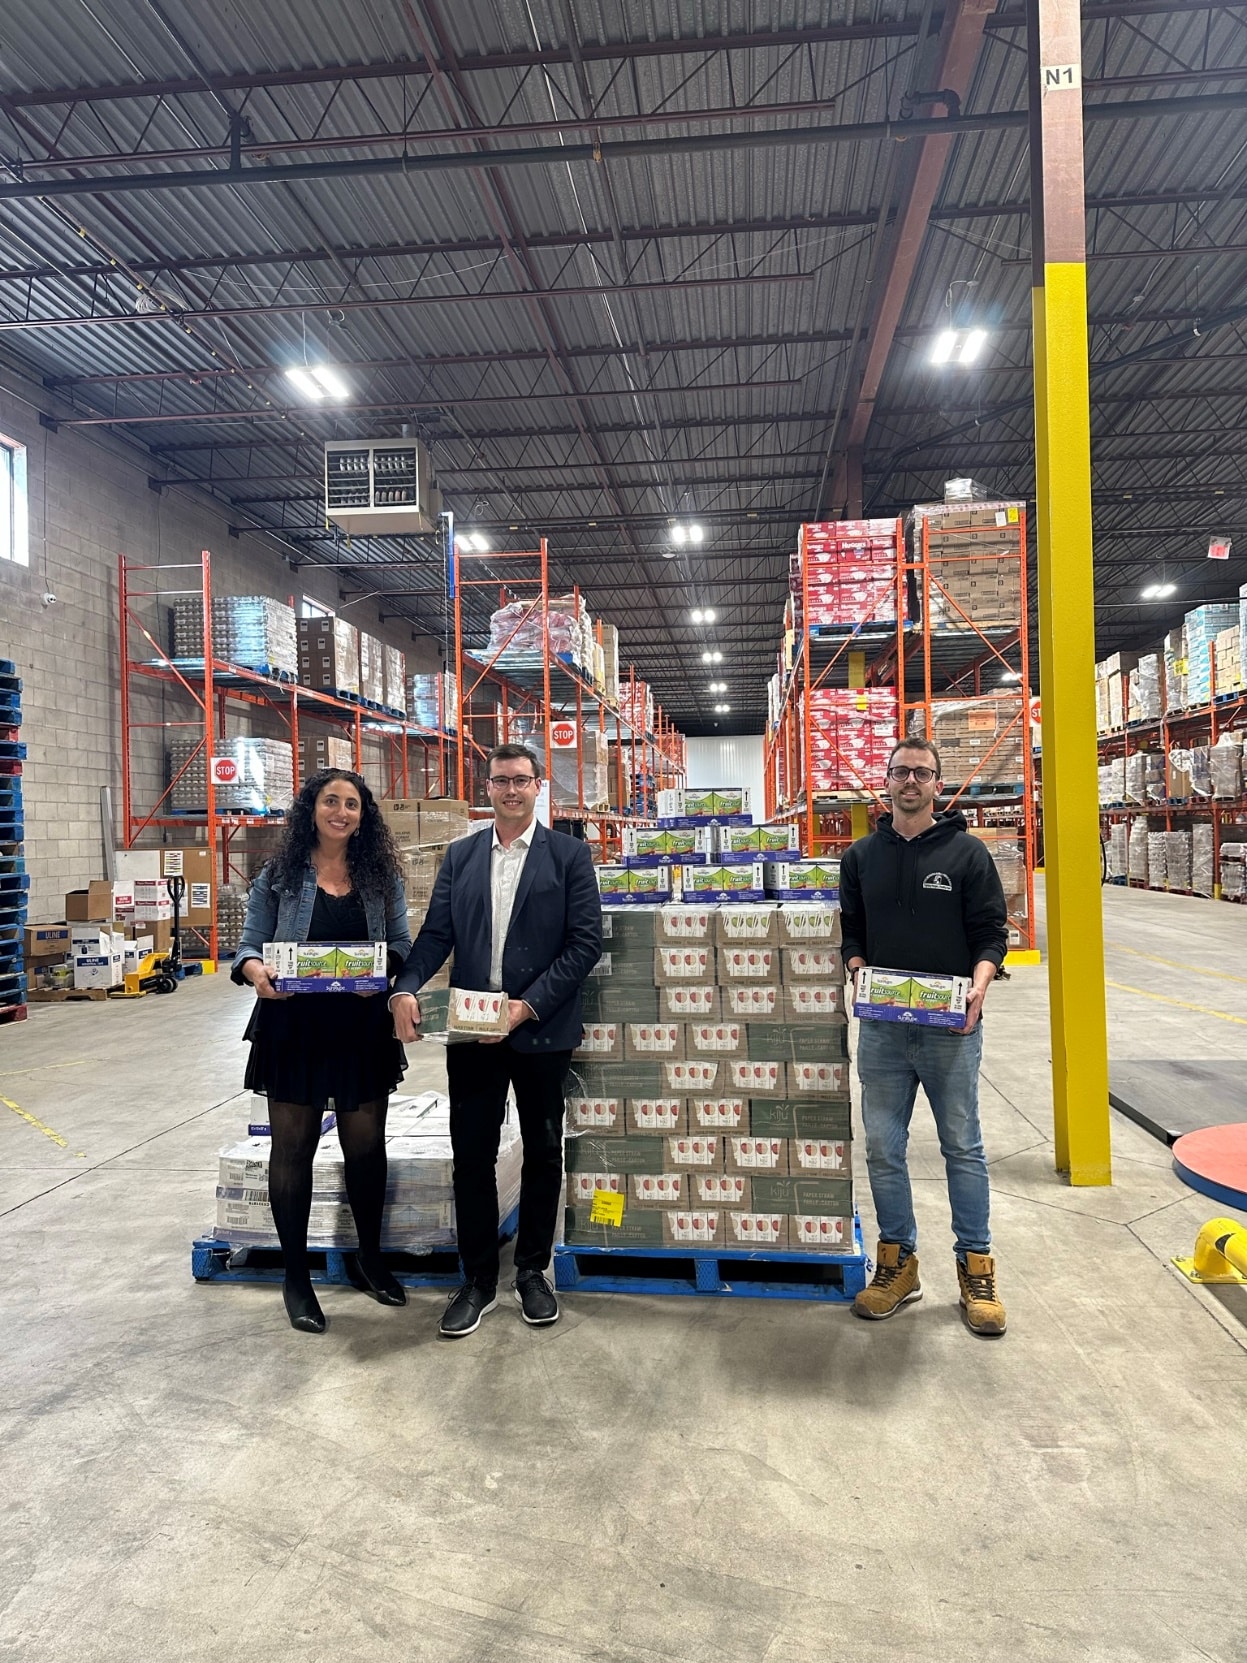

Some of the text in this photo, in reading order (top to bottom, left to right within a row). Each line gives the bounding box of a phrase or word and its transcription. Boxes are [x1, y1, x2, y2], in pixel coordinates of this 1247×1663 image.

[1046, 67, 1072, 85] N1
[1032, 709, 1041, 718] ST
[553, 731, 574, 740] STOP
[216, 766, 235, 775] STOP
[45, 930, 61, 939] ULINE
